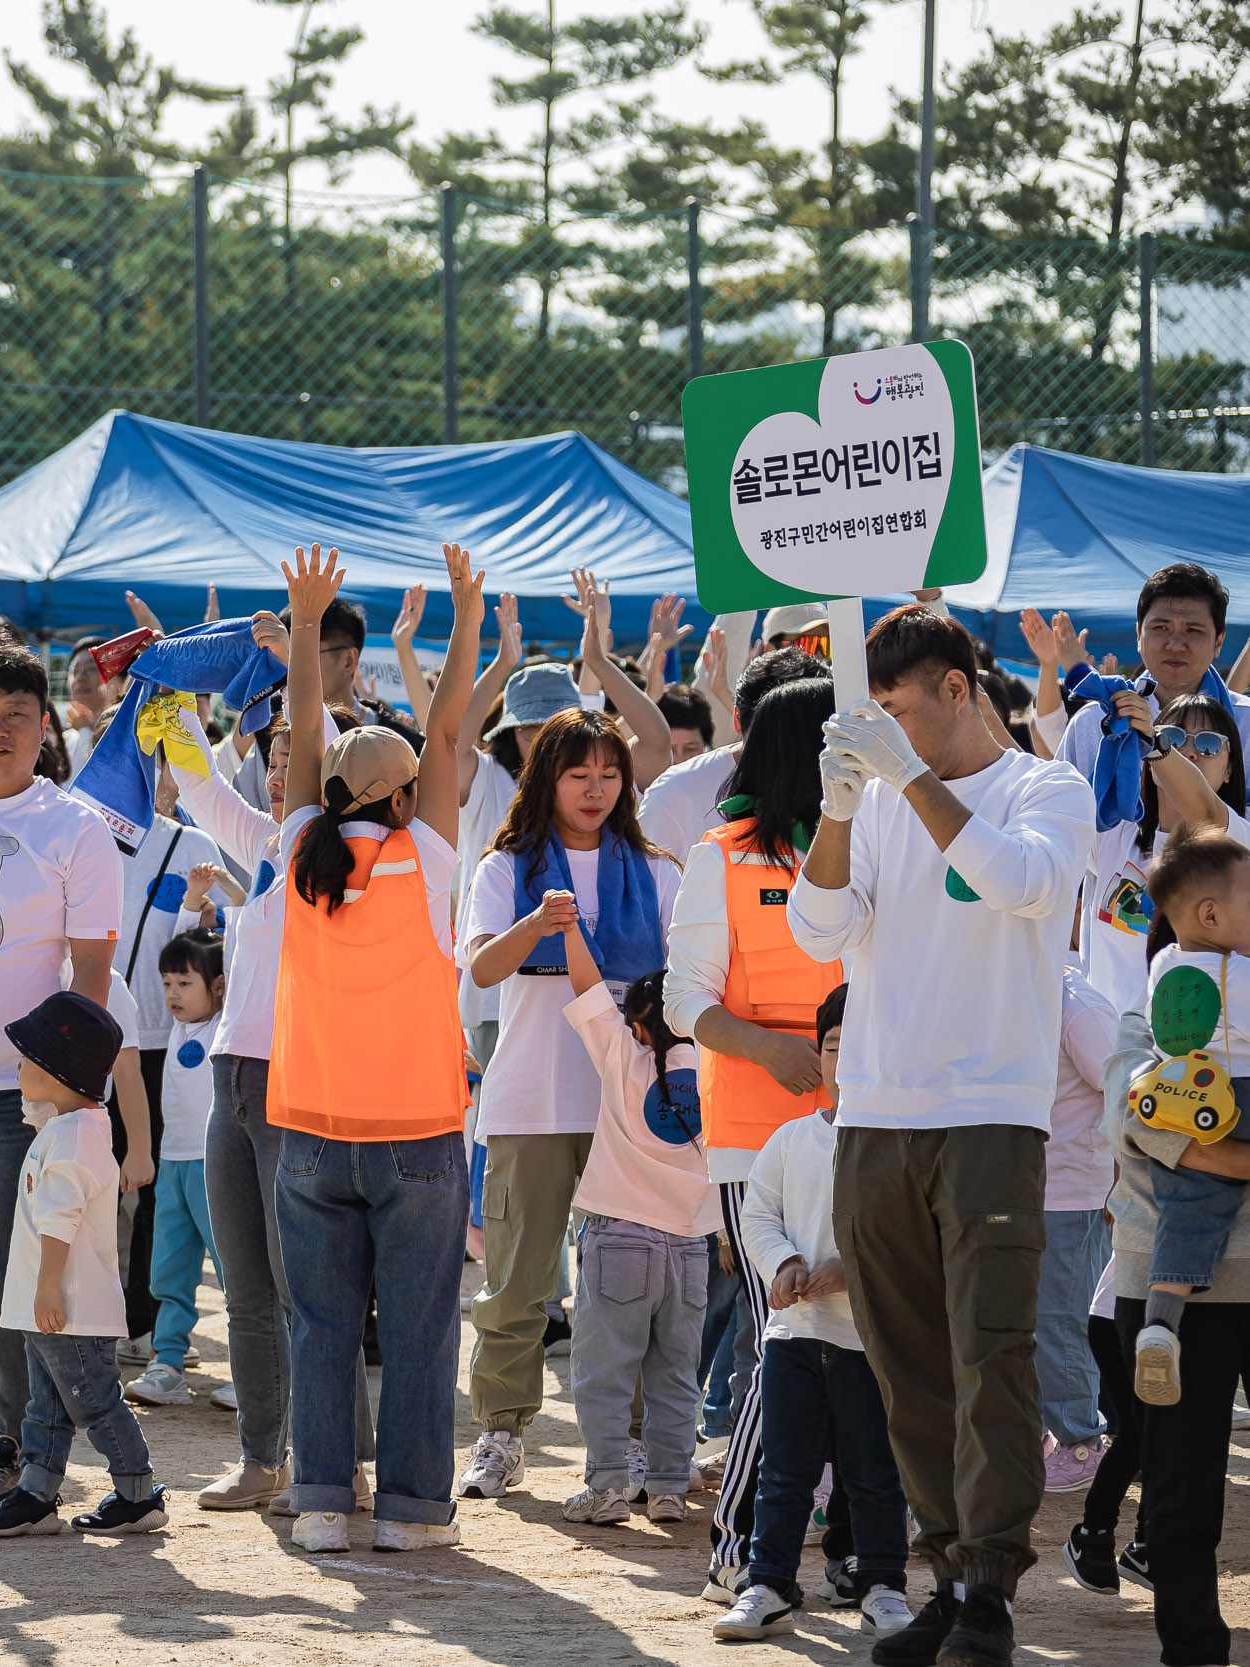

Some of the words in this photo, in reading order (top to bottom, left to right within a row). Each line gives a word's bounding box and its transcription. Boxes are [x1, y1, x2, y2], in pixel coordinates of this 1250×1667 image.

[885, 381, 925, 401] 행복광진
[733, 431, 942, 506] 솔로몬어린이집
[760, 508, 927, 551] 광진구민간어린이집연합회
[536, 966, 557, 974] OMAR
[1153, 1082, 1208, 1102] POLICE
